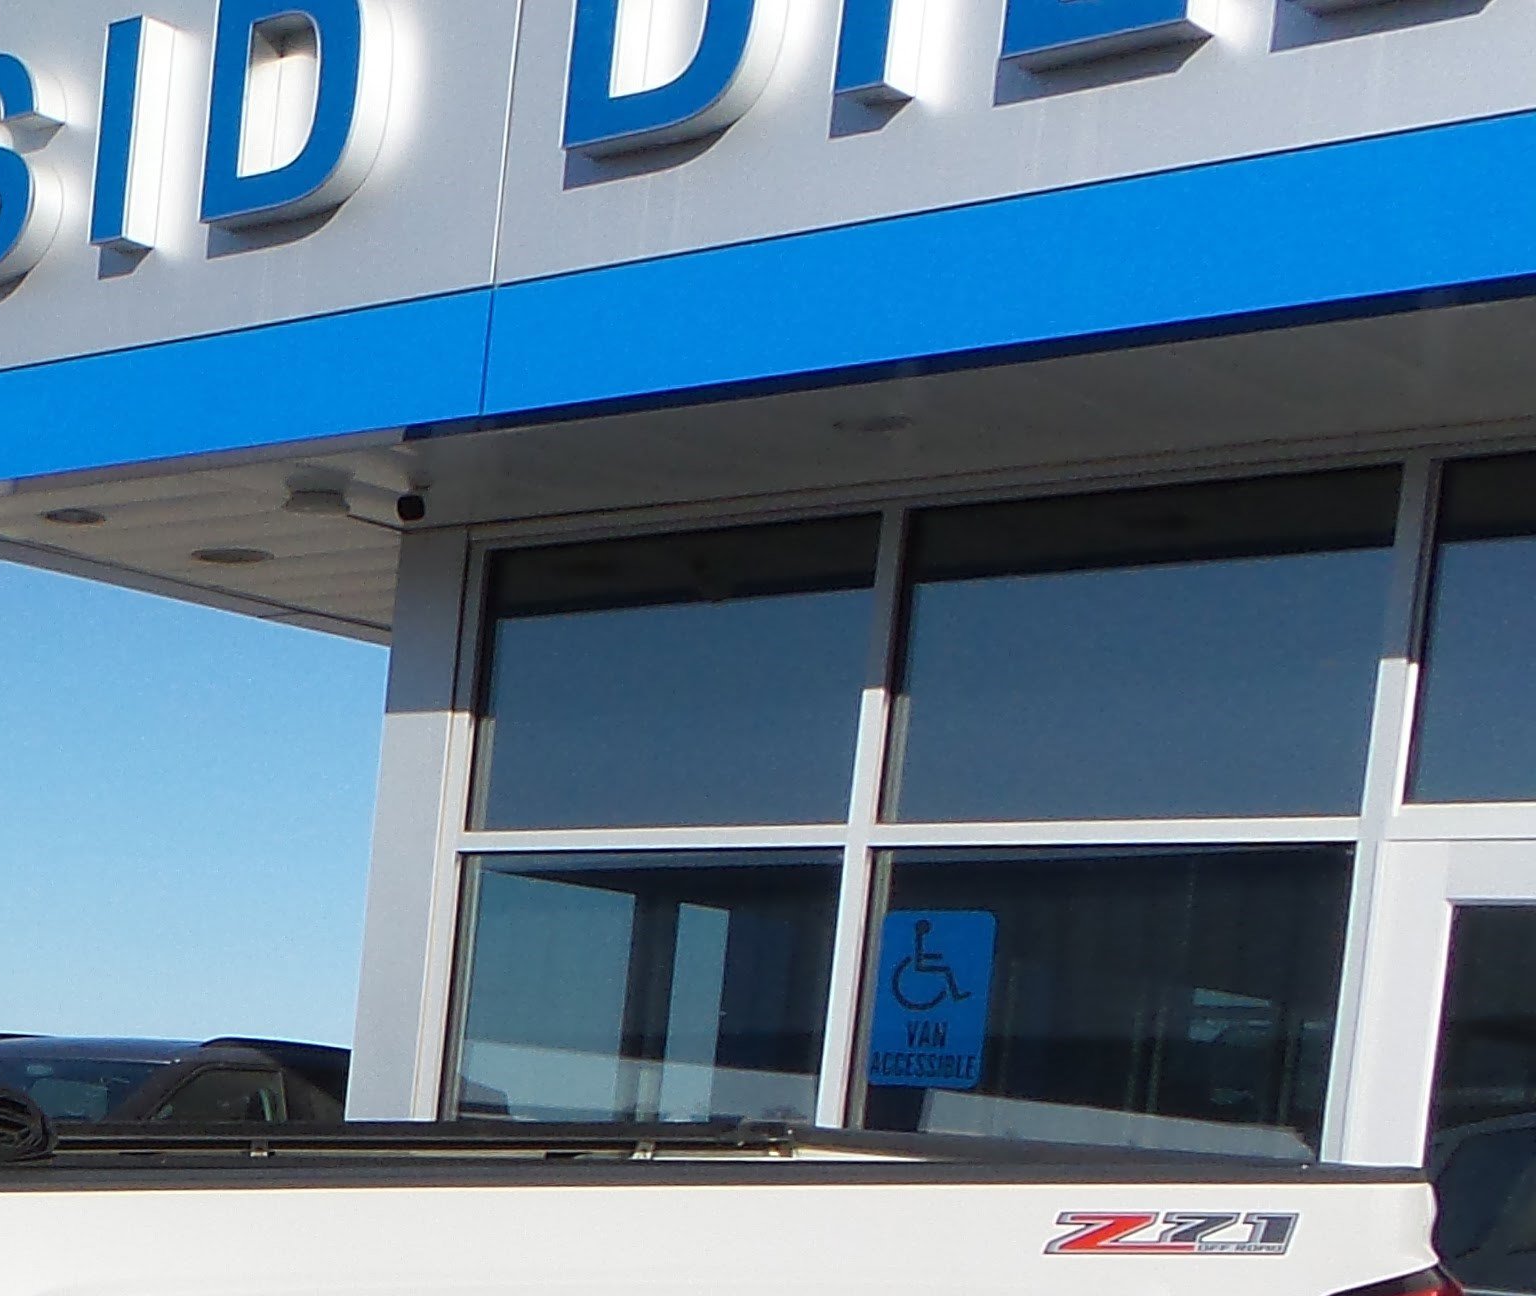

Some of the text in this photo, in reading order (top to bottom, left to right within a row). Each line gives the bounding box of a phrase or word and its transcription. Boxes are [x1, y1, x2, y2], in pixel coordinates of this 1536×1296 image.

[907, 1020, 947, 1048] VAN
[870, 1050, 977, 1079] ACCESSIBLE
[1042, 1211, 1300, 1255] Z71
